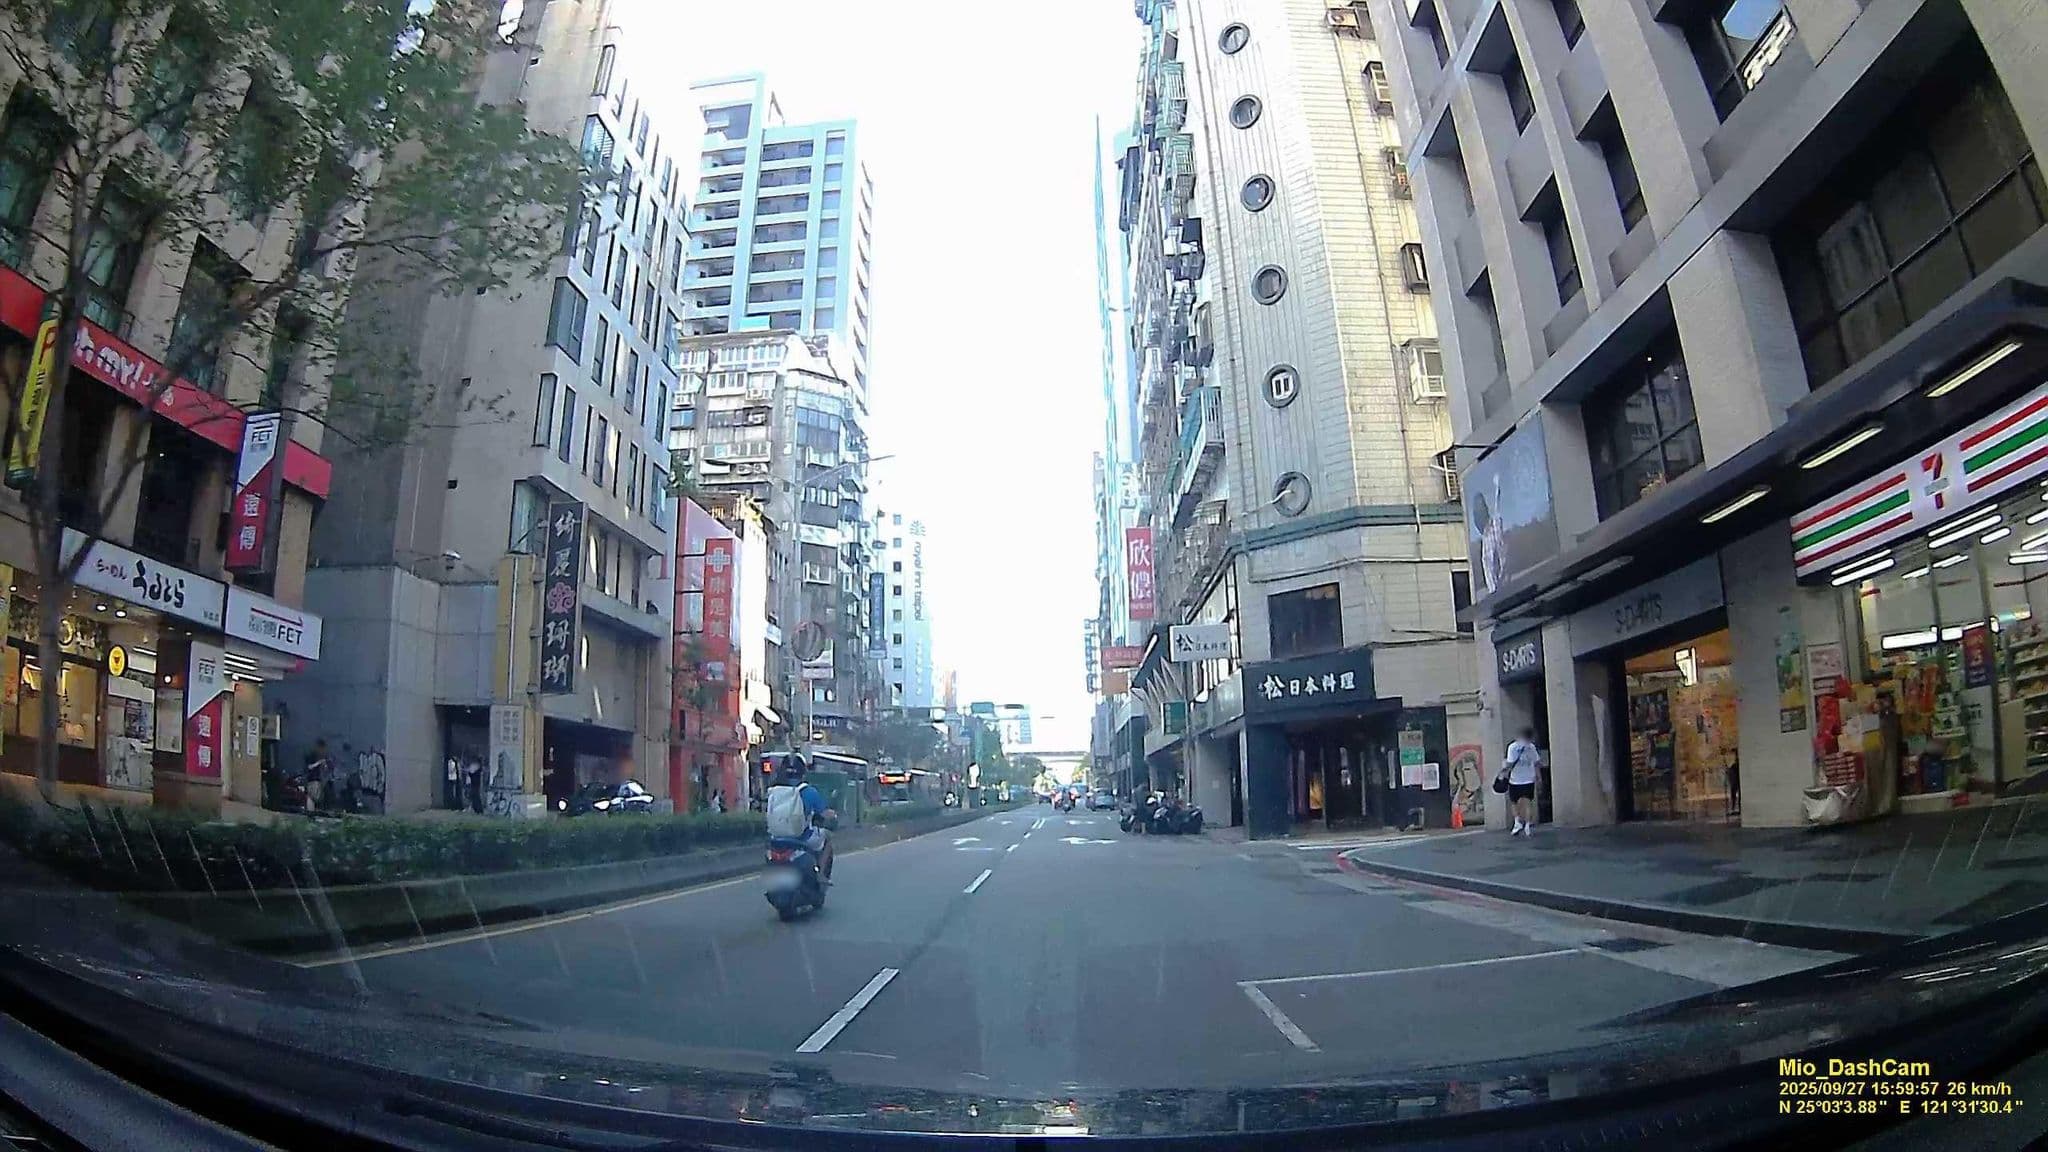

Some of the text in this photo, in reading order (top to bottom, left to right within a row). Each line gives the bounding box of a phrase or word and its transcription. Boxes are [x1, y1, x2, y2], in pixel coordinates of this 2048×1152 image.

[1263, 671, 1356, 701] 松 日本料理
